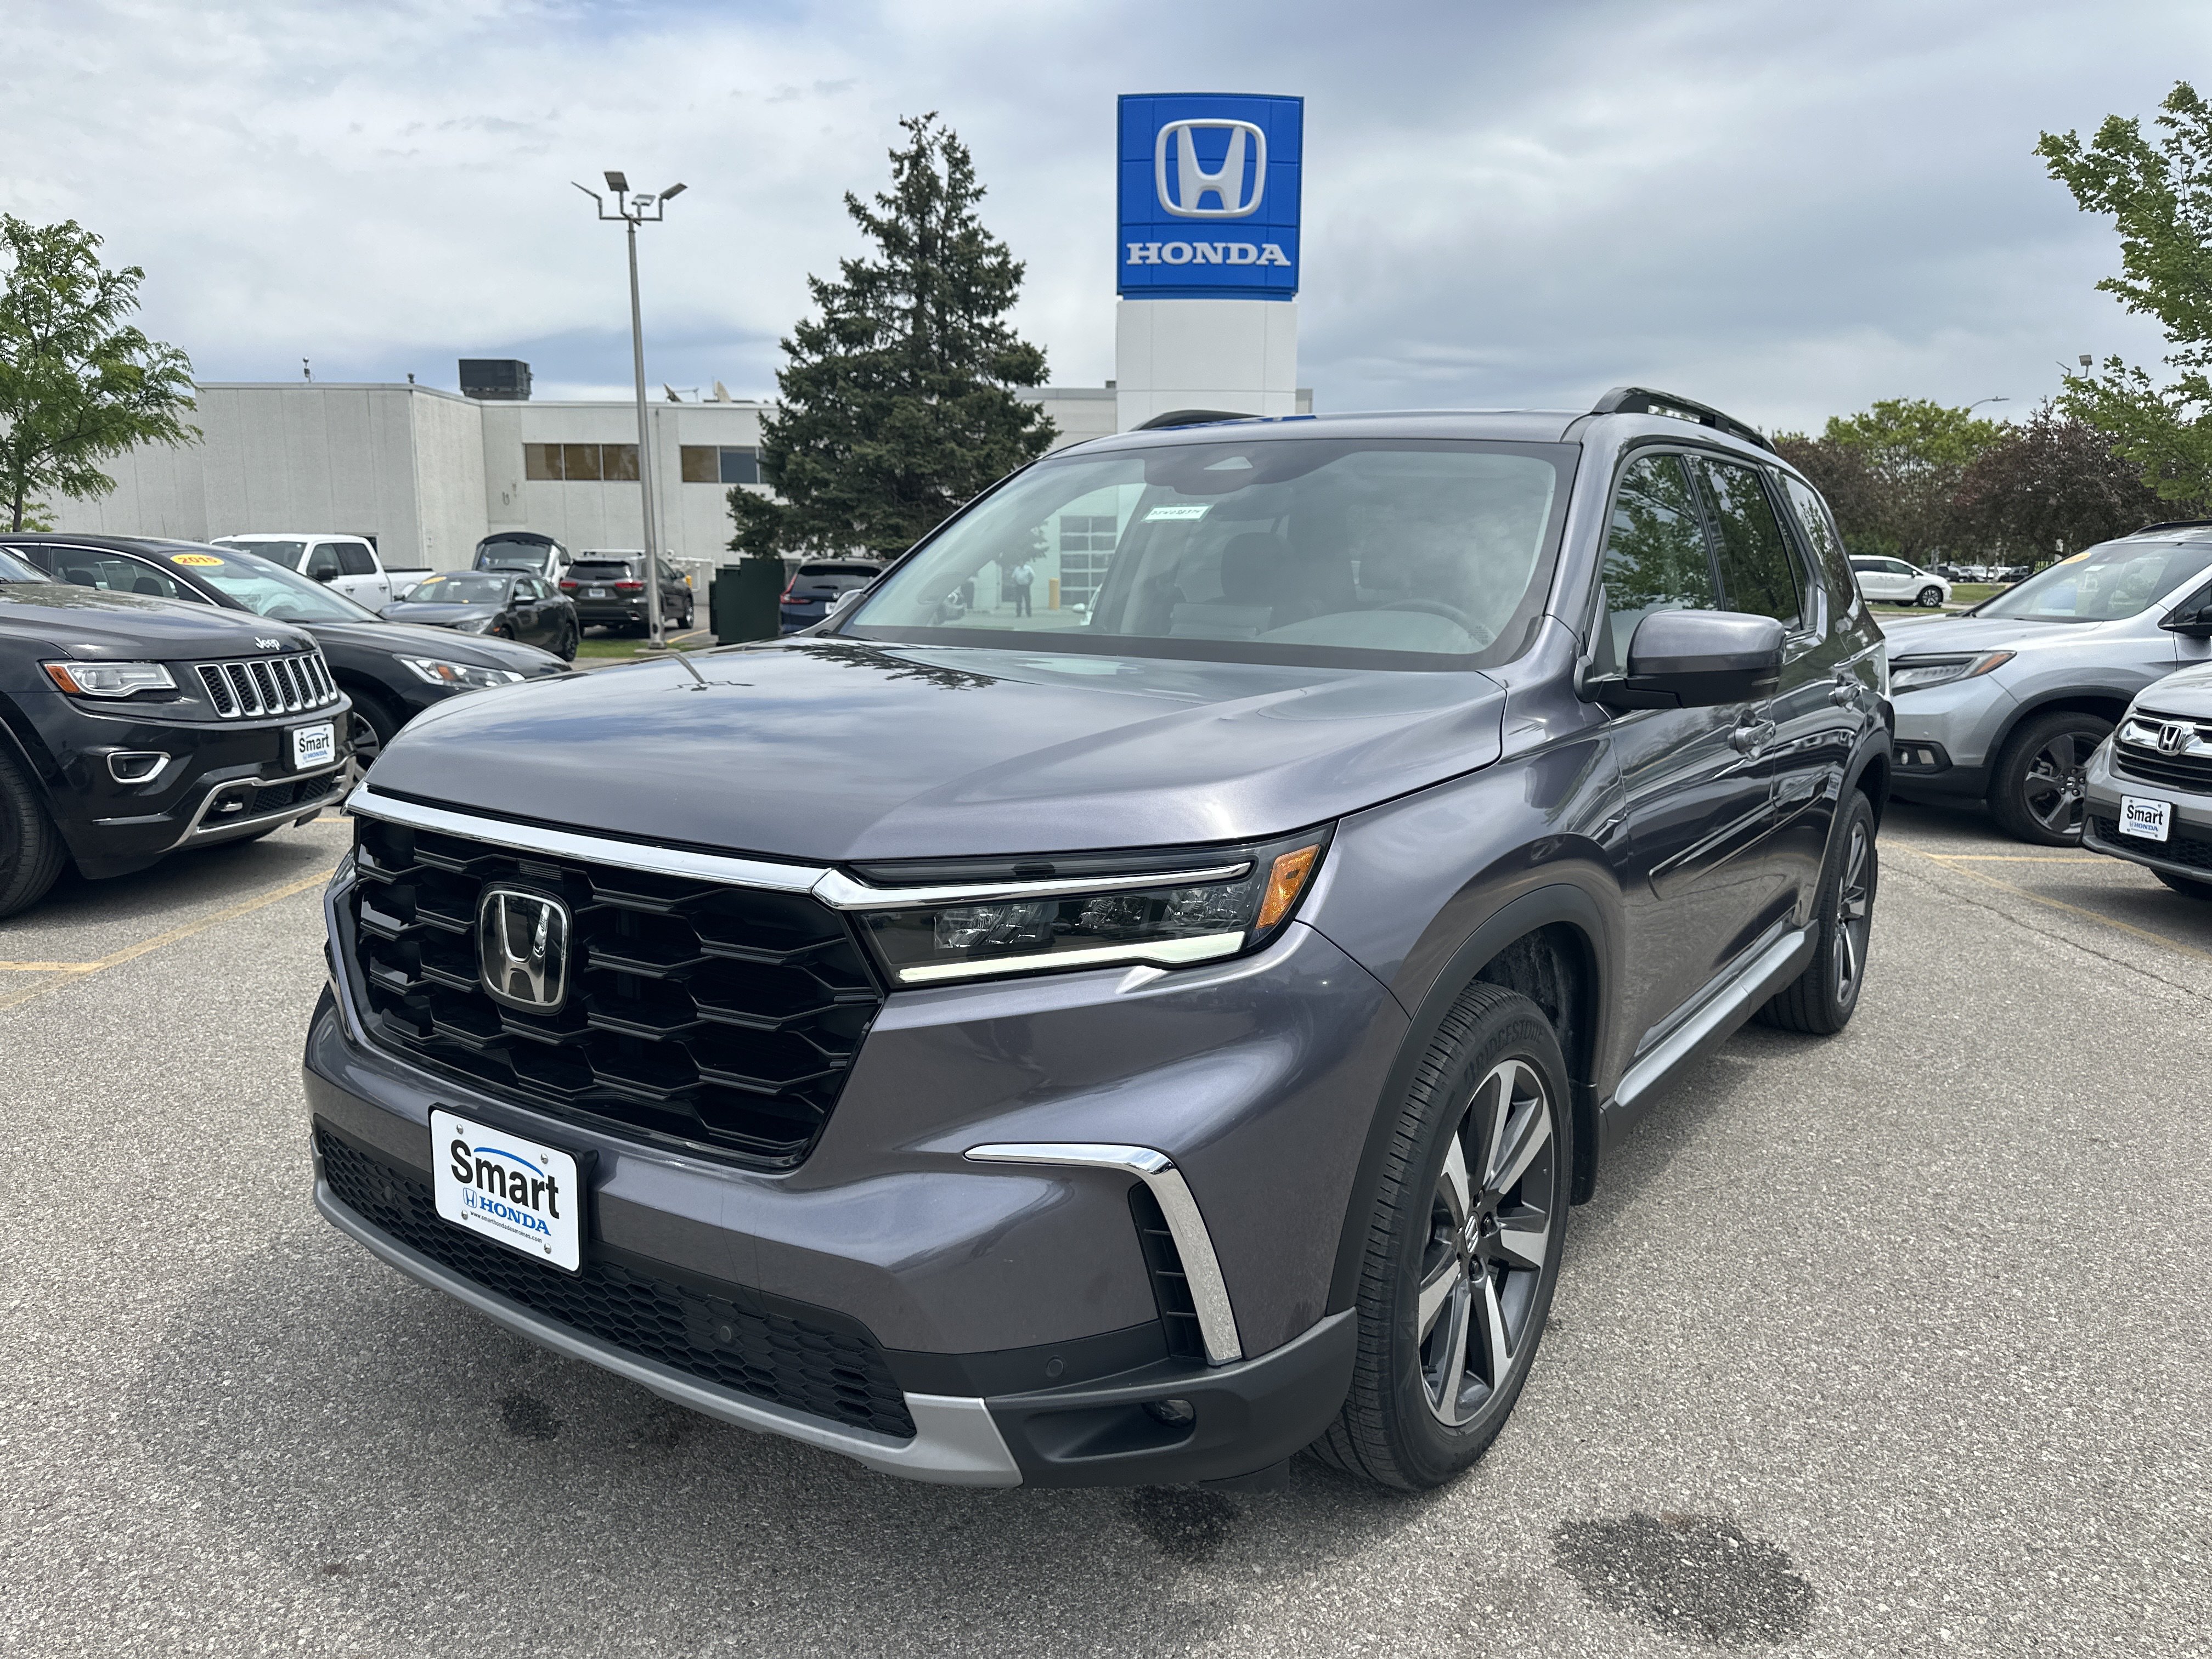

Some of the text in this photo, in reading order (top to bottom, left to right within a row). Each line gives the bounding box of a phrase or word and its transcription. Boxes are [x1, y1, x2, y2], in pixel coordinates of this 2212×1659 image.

[1126, 241, 1291, 266] HONDA
[255, 636, 280, 651] Jeep
[299, 733, 330, 753] Smart
[307, 750, 328, 758] HONDA
[2126, 804, 2163, 825] Smart
[2134, 822, 2159, 832] HONDA
[450, 1139, 560, 1219] Smart
[479, 1196, 551, 1236] HONDA
[470, 1211, 543, 1244] www.smarthondadesmoines.com
